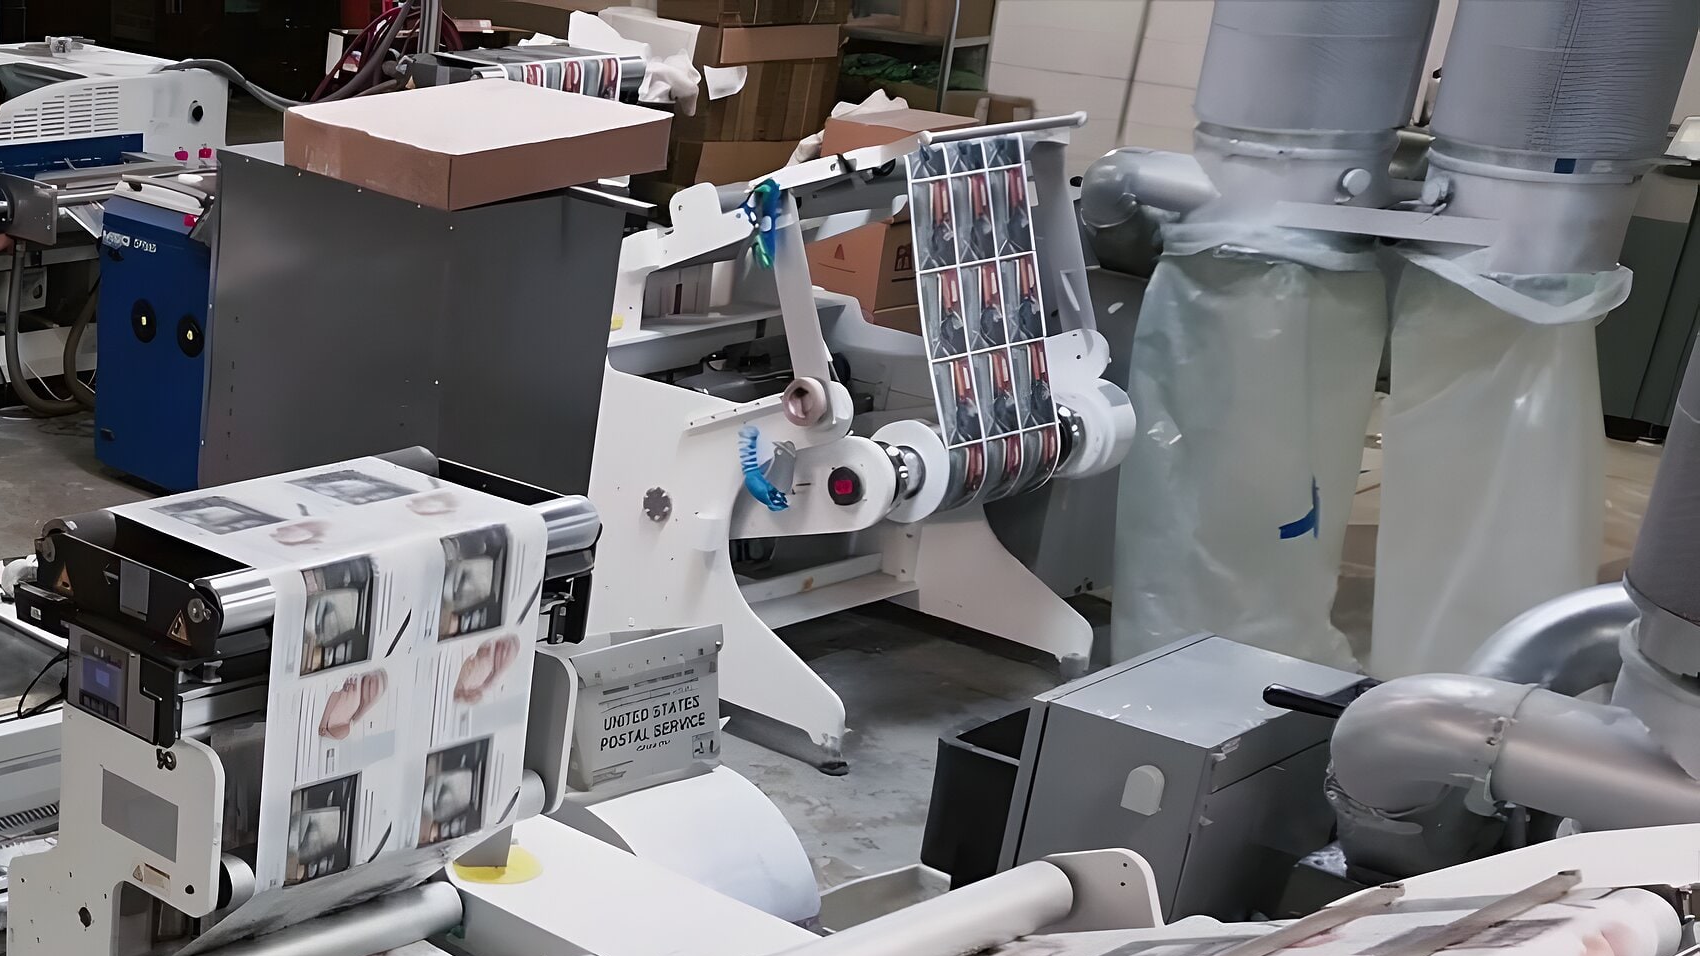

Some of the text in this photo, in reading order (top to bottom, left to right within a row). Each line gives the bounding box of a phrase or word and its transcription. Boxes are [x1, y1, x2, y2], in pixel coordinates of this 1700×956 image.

[600, 727, 650, 751] POSTAL
[653, 711, 706, 738] SERVICE
[603, 695, 700, 731] UNITED STATES
